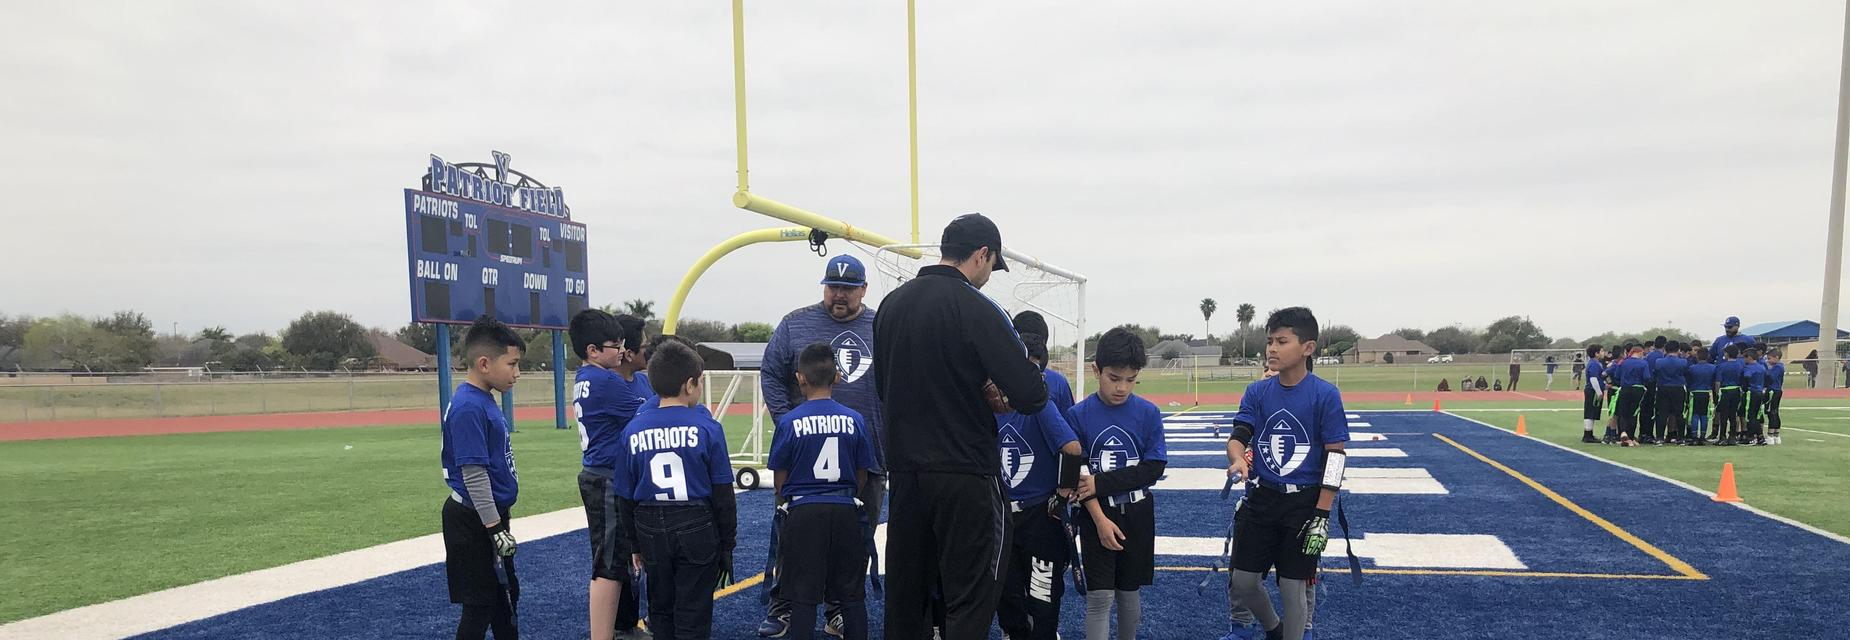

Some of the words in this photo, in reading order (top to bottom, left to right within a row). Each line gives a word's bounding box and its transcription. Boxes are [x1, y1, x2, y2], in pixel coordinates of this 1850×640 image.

[492, 150, 511, 183] V
[430, 154, 514, 207] PATRIOT
[519, 186, 565, 218] FIELD
[414, 195, 458, 218] PATRIOTS
[465, 213, 477, 229] TOL
[539, 227, 550, 241] TOL
[560, 223, 585, 242] VISITOR
[417, 260, 440, 280] BALL
[444, 263, 458, 281] ON
[482, 267, 498, 286] QTR
[836, 262, 850, 278] V
[524, 272, 547, 291] DOWN
[565, 278, 573, 293] TO
[576, 279, 585, 294] GO
[793, 414, 855, 438] PATRIOTS
[630, 426, 699, 455] PATRIOTS
[812, 436, 841, 483] 4
[649, 451, 689, 501] 9
[1029, 555, 1054, 603] NIKE
